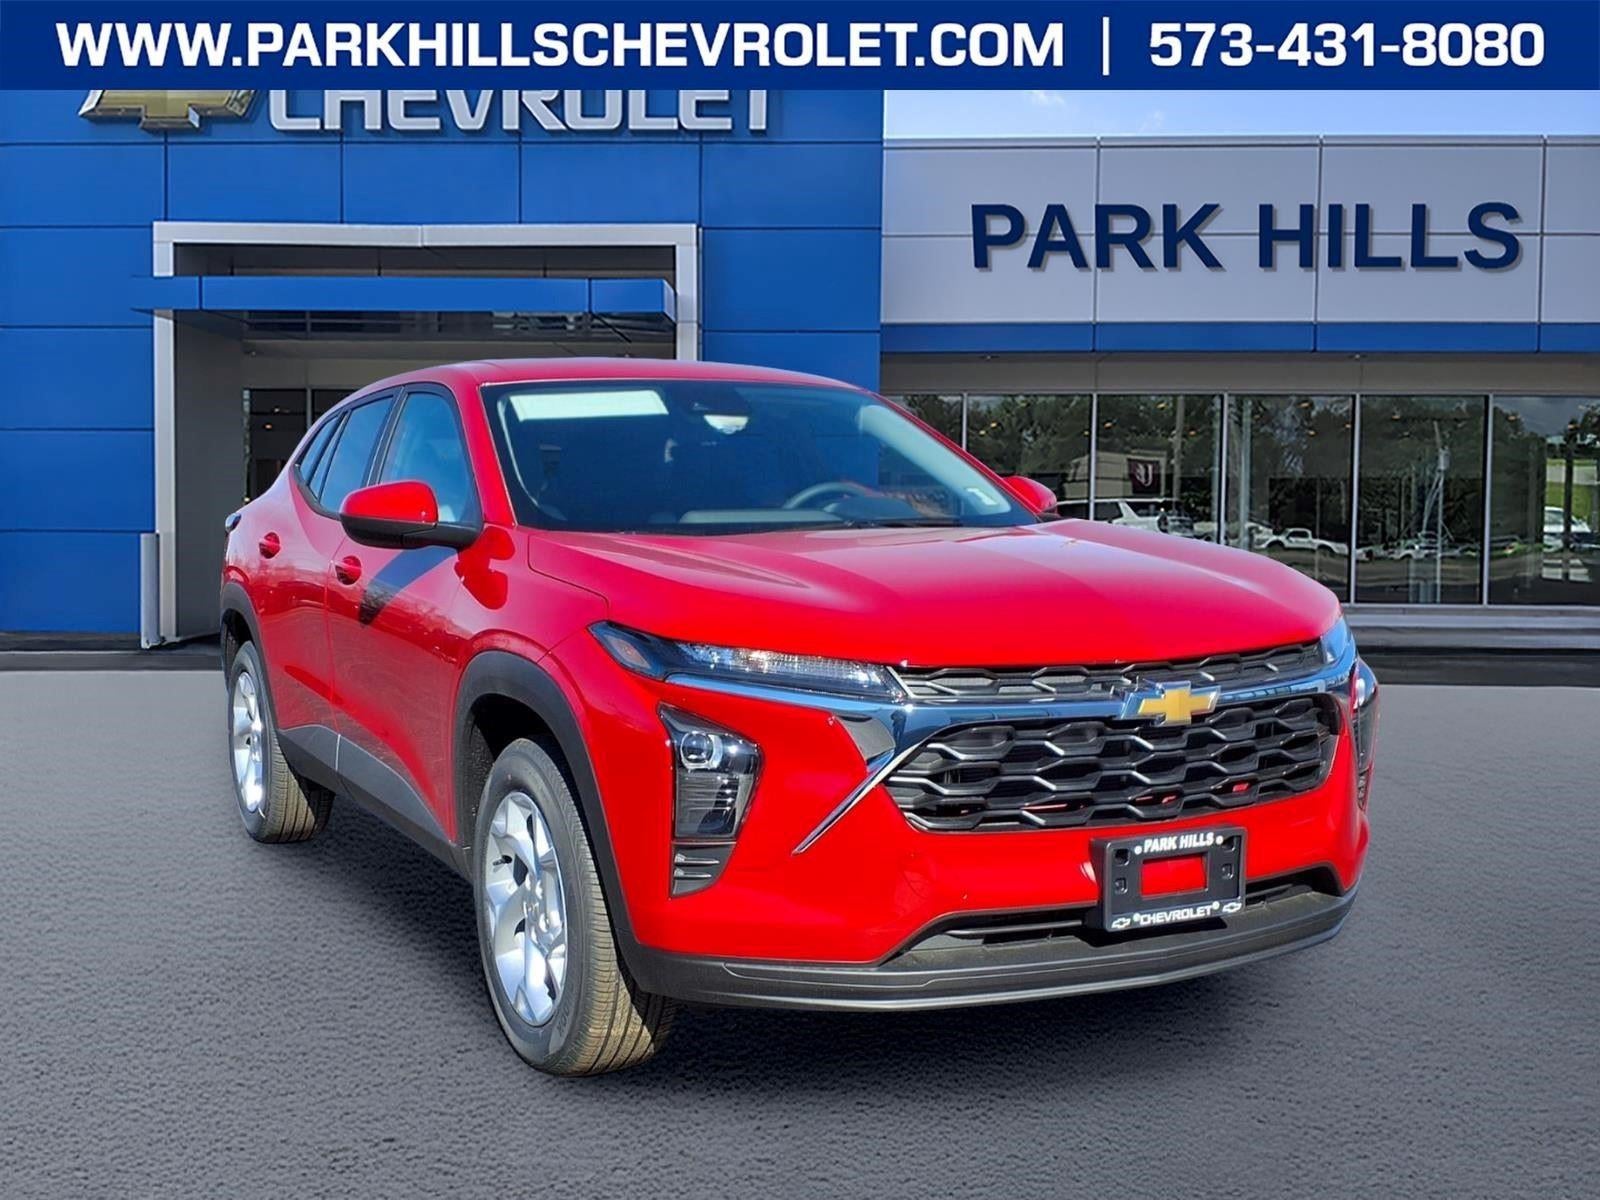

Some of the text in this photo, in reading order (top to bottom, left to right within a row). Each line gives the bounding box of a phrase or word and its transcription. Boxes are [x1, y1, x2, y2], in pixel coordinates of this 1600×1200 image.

[971, 201, 1522, 270] PARK HILLS
[1143, 831, 1215, 853] PARK HILLS
[1139, 905, 1213, 926] CHEVROLET
